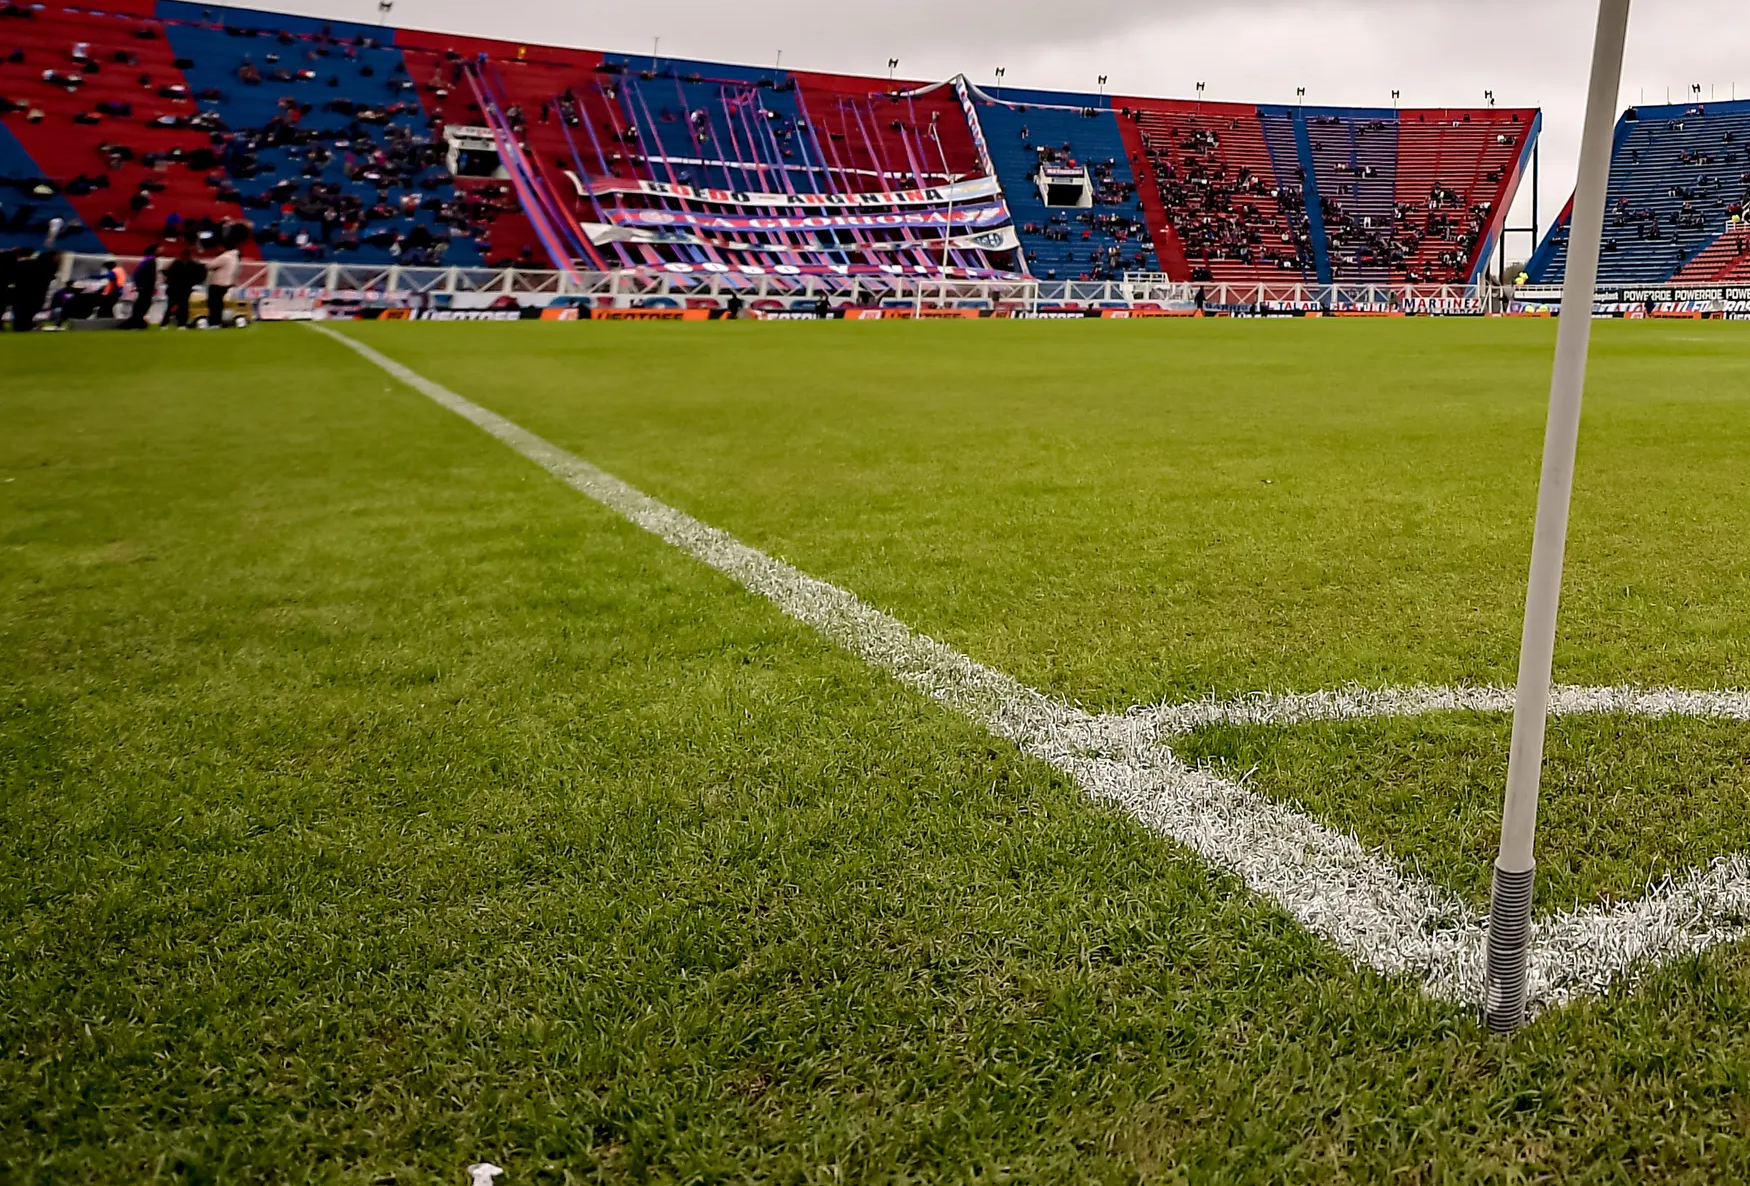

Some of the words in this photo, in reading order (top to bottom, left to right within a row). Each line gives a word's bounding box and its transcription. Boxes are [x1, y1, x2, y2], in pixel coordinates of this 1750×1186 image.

[786, 188, 944, 205] ARGENTINA
[749, 208, 948, 228] GLORIOSA
[1624, 290, 1672, 301] POWERADE
[1675, 289, 1723, 301] POWERADE
